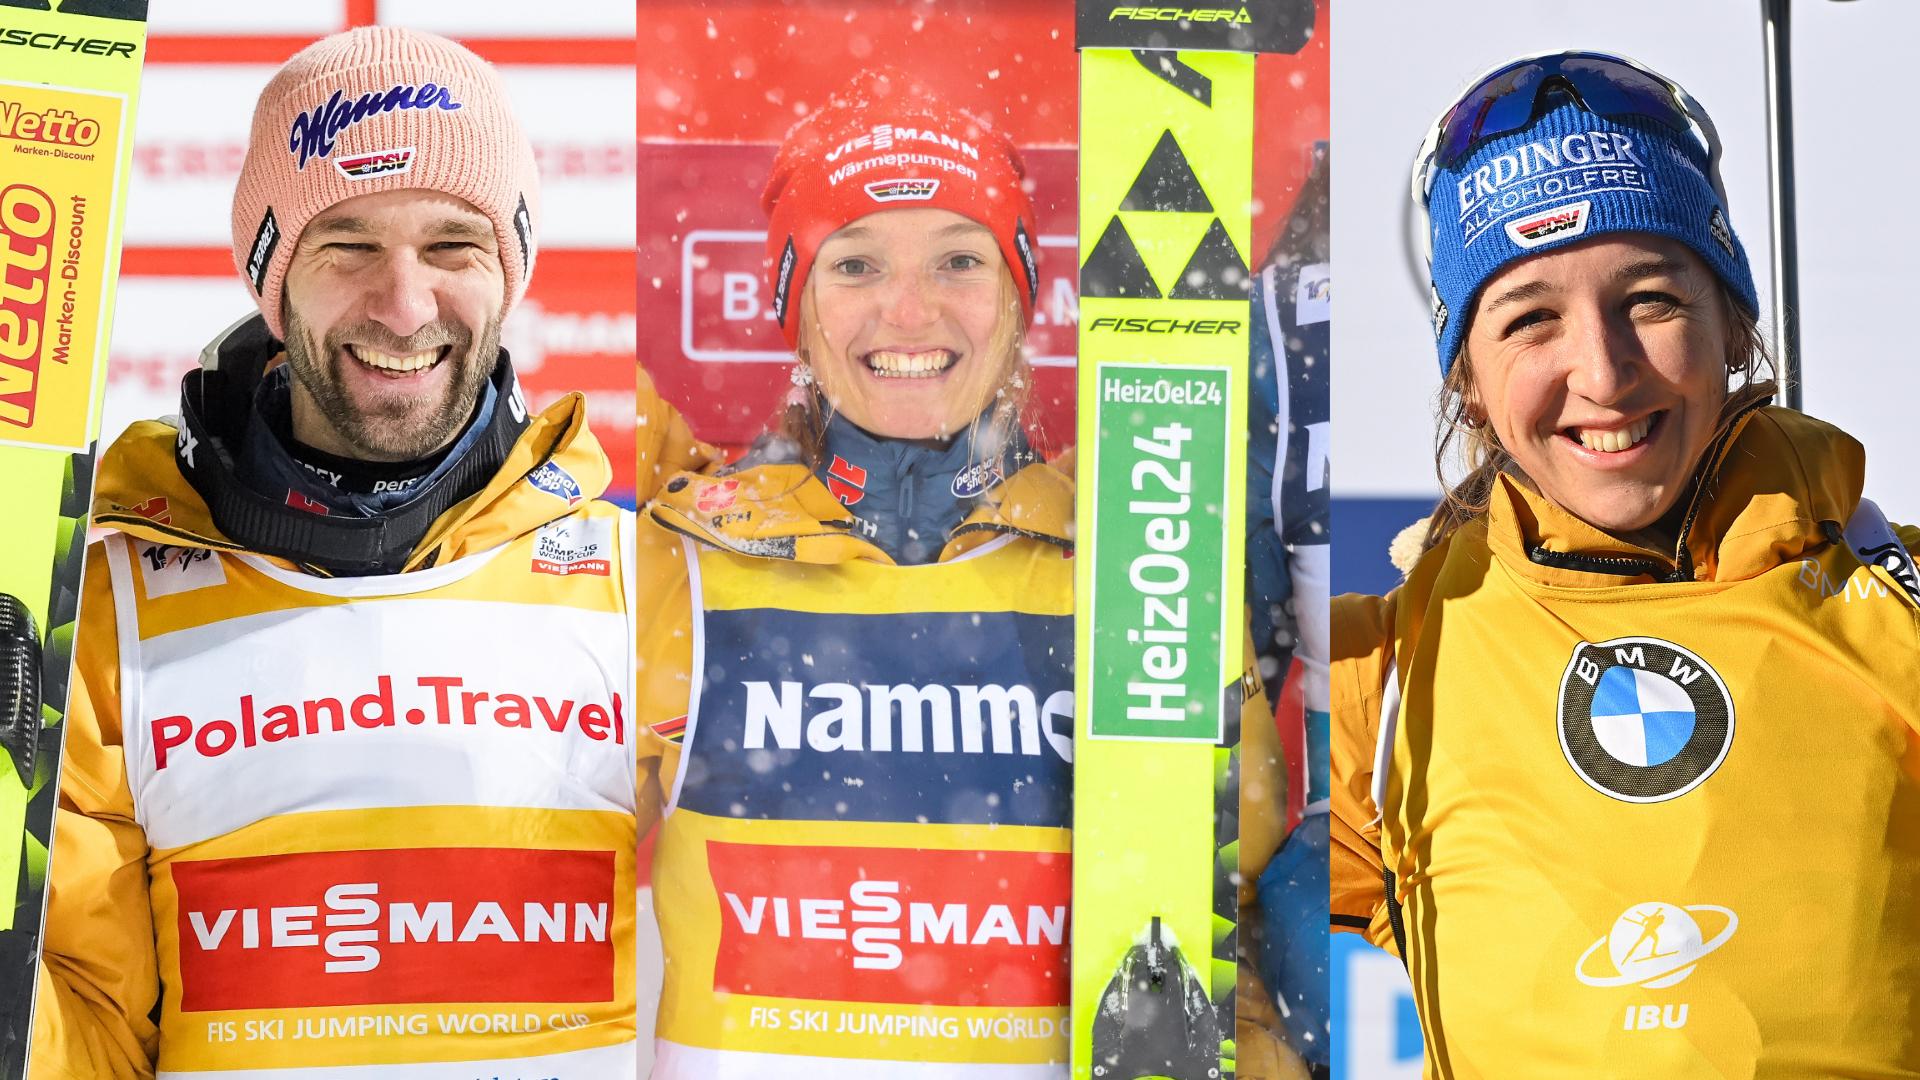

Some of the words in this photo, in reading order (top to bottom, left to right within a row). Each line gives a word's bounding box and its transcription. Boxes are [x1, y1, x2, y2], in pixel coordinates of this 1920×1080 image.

[1108, 7, 1237, 23] FISCHER
[290, 83, 462, 171] Manner
[825, 124, 979, 161] VIESSMANN
[13, 144, 95, 161] Marken-Discount
[371, 151, 411, 172] DSV
[828, 153, 977, 186] Wärmepumpen
[897, 181, 936, 196] DSV
[1458, 131, 1646, 217] ERDINGER
[1465, 169, 1646, 237] ALKOHOLFREI
[1544, 209, 1580, 233] DSV
[253, 217, 275, 270] TERREX
[52, 195, 87, 365] Marken-Discount
[1089, 318, 1242, 335] FISCHER
[1104, 378, 1222, 405] HeizOel24
[1126, 422, 1193, 721] HeizOel24
[1799, 557, 1889, 603] BMW
[1576, 646, 1702, 686] BMW
[151, 675, 625, 770] Poland.Travel
[188, 883, 608, 974] VIESSMANN
[723, 880, 1072, 970] VIESSMAN
[207, 1020, 237, 1043] FIS
[245, 1019, 284, 1041] SKI
[292, 1014, 428, 1040] JUMPING
[438, 1012, 541, 1034] WORLD
[545, 1012, 590, 1032] CUP
[750, 1007, 782, 1029] FIS
[788, 1010, 828, 1032] SKI
[835, 1012, 959, 1039] JUMPING
[966, 1014, 1055, 1039] WORLD
[1623, 1003, 1689, 1031] IBU
